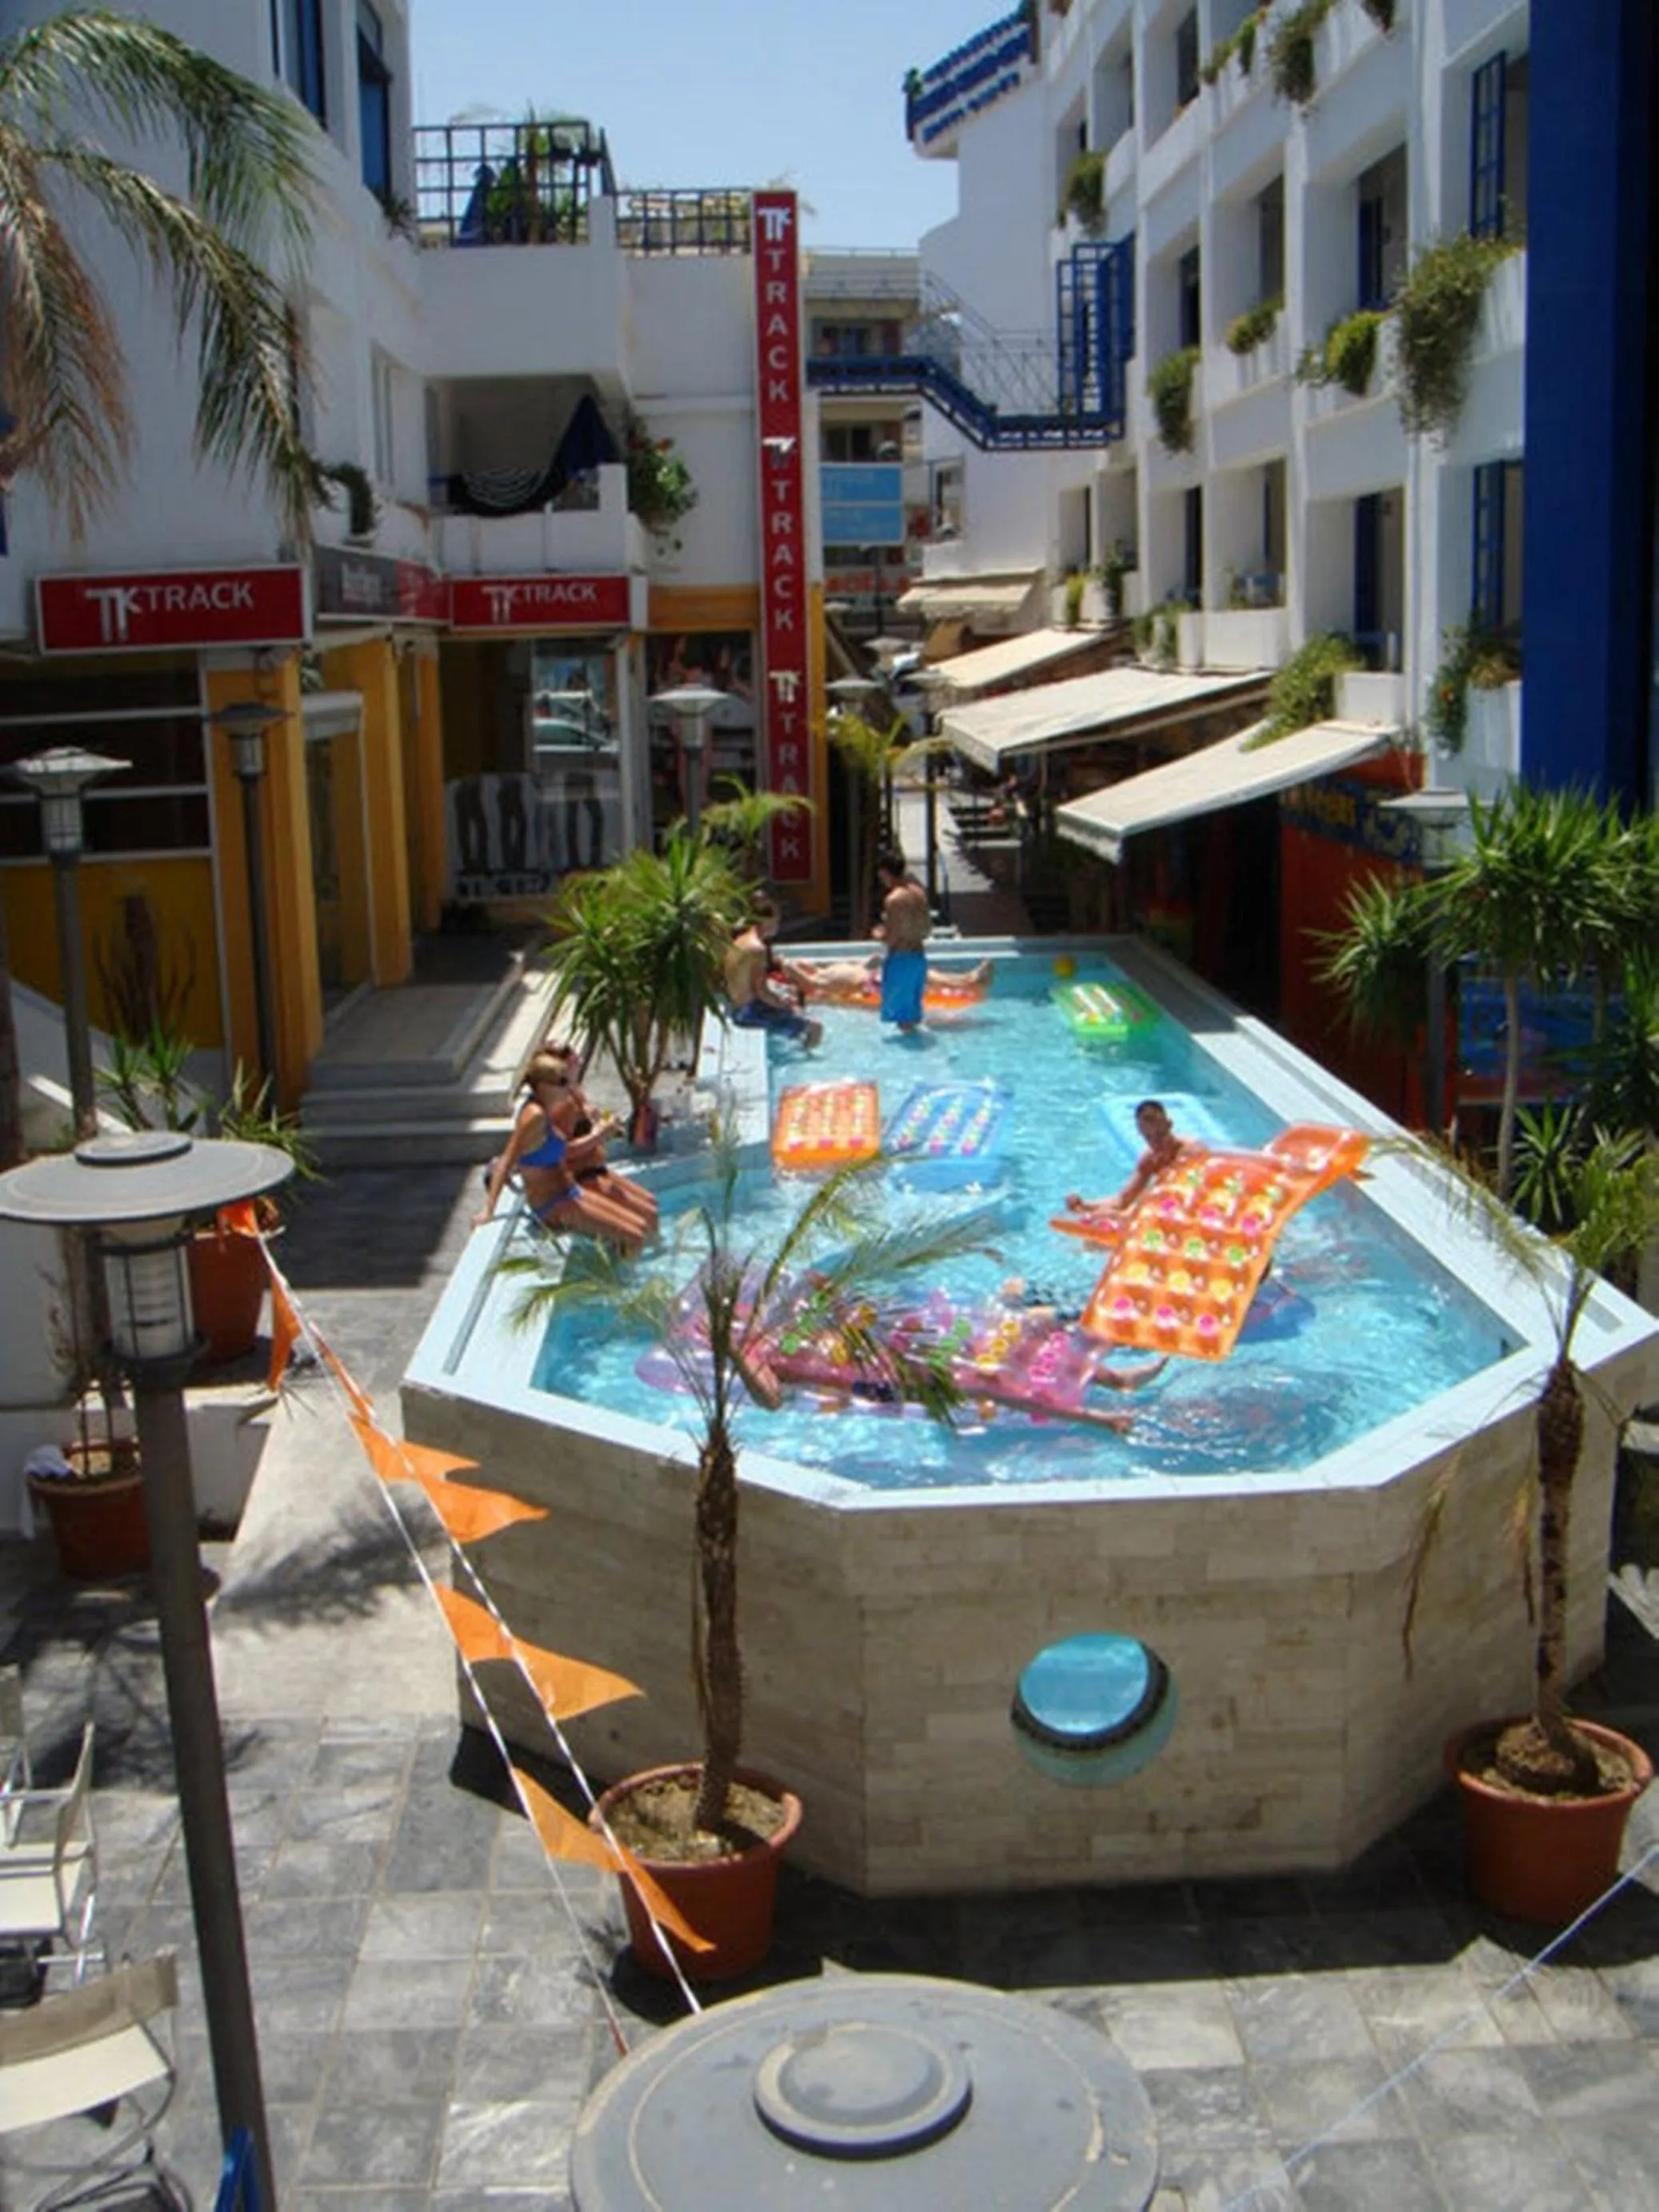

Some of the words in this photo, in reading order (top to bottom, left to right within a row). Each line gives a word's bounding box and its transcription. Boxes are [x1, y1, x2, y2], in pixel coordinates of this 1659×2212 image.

[766, 249, 789, 402] TRACK
[145, 582, 254, 610] TRACK
[524, 582, 596, 602] TRACK
[772, 482, 794, 630] TRACK
